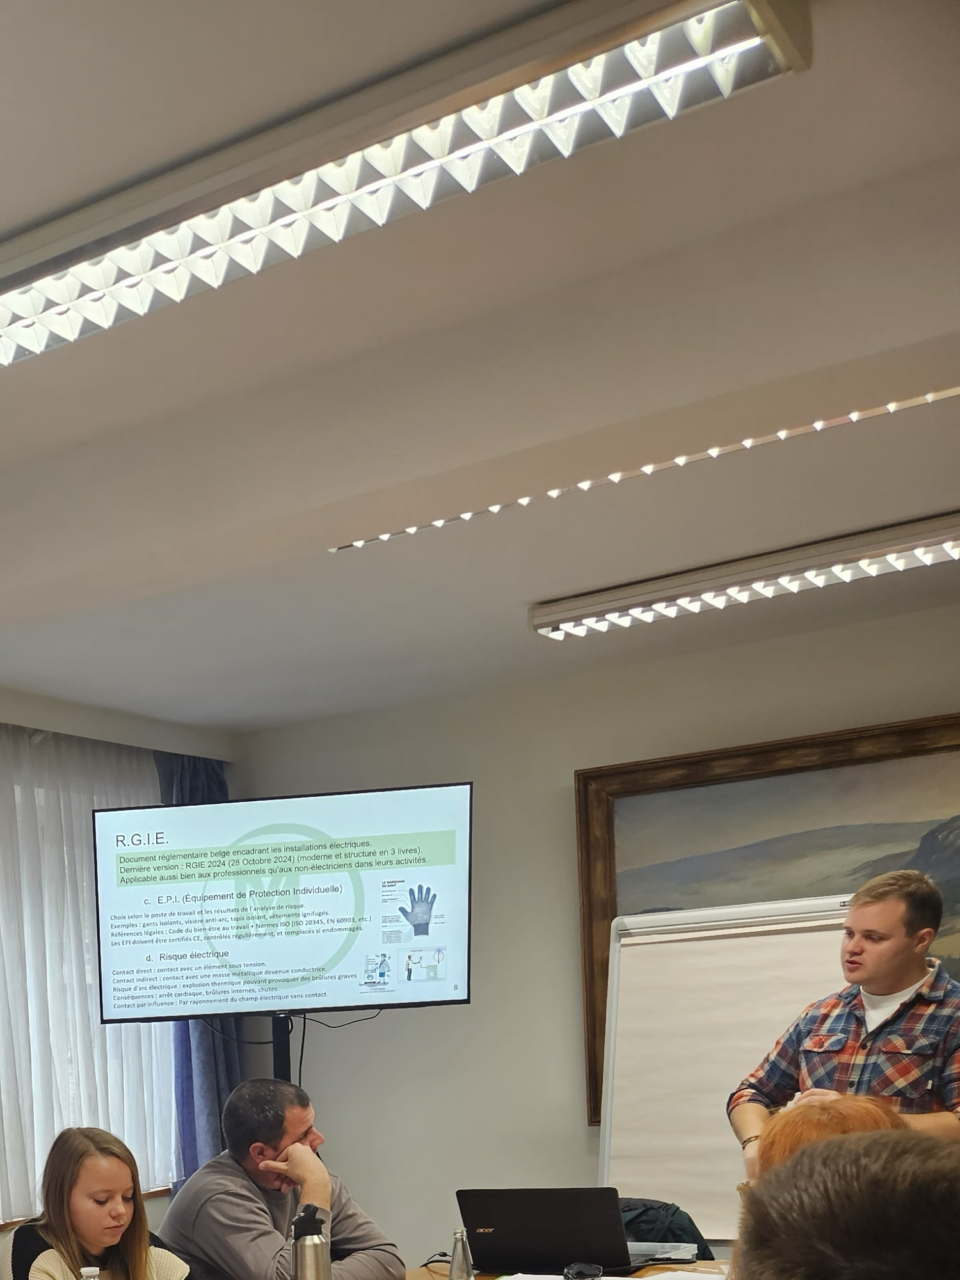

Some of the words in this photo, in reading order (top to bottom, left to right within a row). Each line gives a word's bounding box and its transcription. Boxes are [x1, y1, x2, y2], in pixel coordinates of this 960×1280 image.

[115, 831, 168, 847] R.G.I.E.
[118, 854, 156, 864] Document
[157, 851, 208, 862] réglementaire
[209, 849, 230, 858] belge
[231, 846, 269, 856] encadrant
[283, 843, 327, 852] installations
[328, 840, 370, 849] électriques.
[118, 864, 151, 874] Dernière
[151, 863, 179, 871] version
[184, 860, 205, 869] RGIE
[207, 859, 226, 868] 2024
[227, 858, 240, 867] (28
[241, 857, 271, 865] Octobre
[273, 854, 295, 863] 2024)
[296, 853, 333, 862] (moderne
[334, 851, 342, 859] et
[343, 849, 377, 858] structuré
[390, 847, 396, 855] 3
[119, 874, 157, 884] Applicable
[179, 872, 196, 880] bien
[212, 867, 266, 878] professionnels
[267, 865, 292, 875] qu'aux
[293, 861, 353, 872] non-électriciens
[353, 860, 373, 868] dans
[394, 856, 428, 865] activités.
[157, 894, 180, 904] E.P.I.
[181, 891, 234, 904] (Équipement
[235, 890, 246, 899] de
[248, 888, 290, 899] Protection
[292, 884, 342, 895] Individuelle)
[109, 921, 138, 929] Exemples
[183, 916, 204, 924] visière
[245, 913, 268, 921] isolant,
[143, 928, 164, 936] légales
[193, 925, 220, 933] bien-être
[202, 933, 231, 941] contrôlés
[283, 928, 315, 936] remplacés
[158, 952, 187, 961] Risque
[189, 949, 229, 959] électrique
[267, 976, 299, 984] provoquer
[453, 983, 458, 991] 8
[112, 993, 154, 1001] Conséquences
[189, 997, 228, 1005] rayonnement
